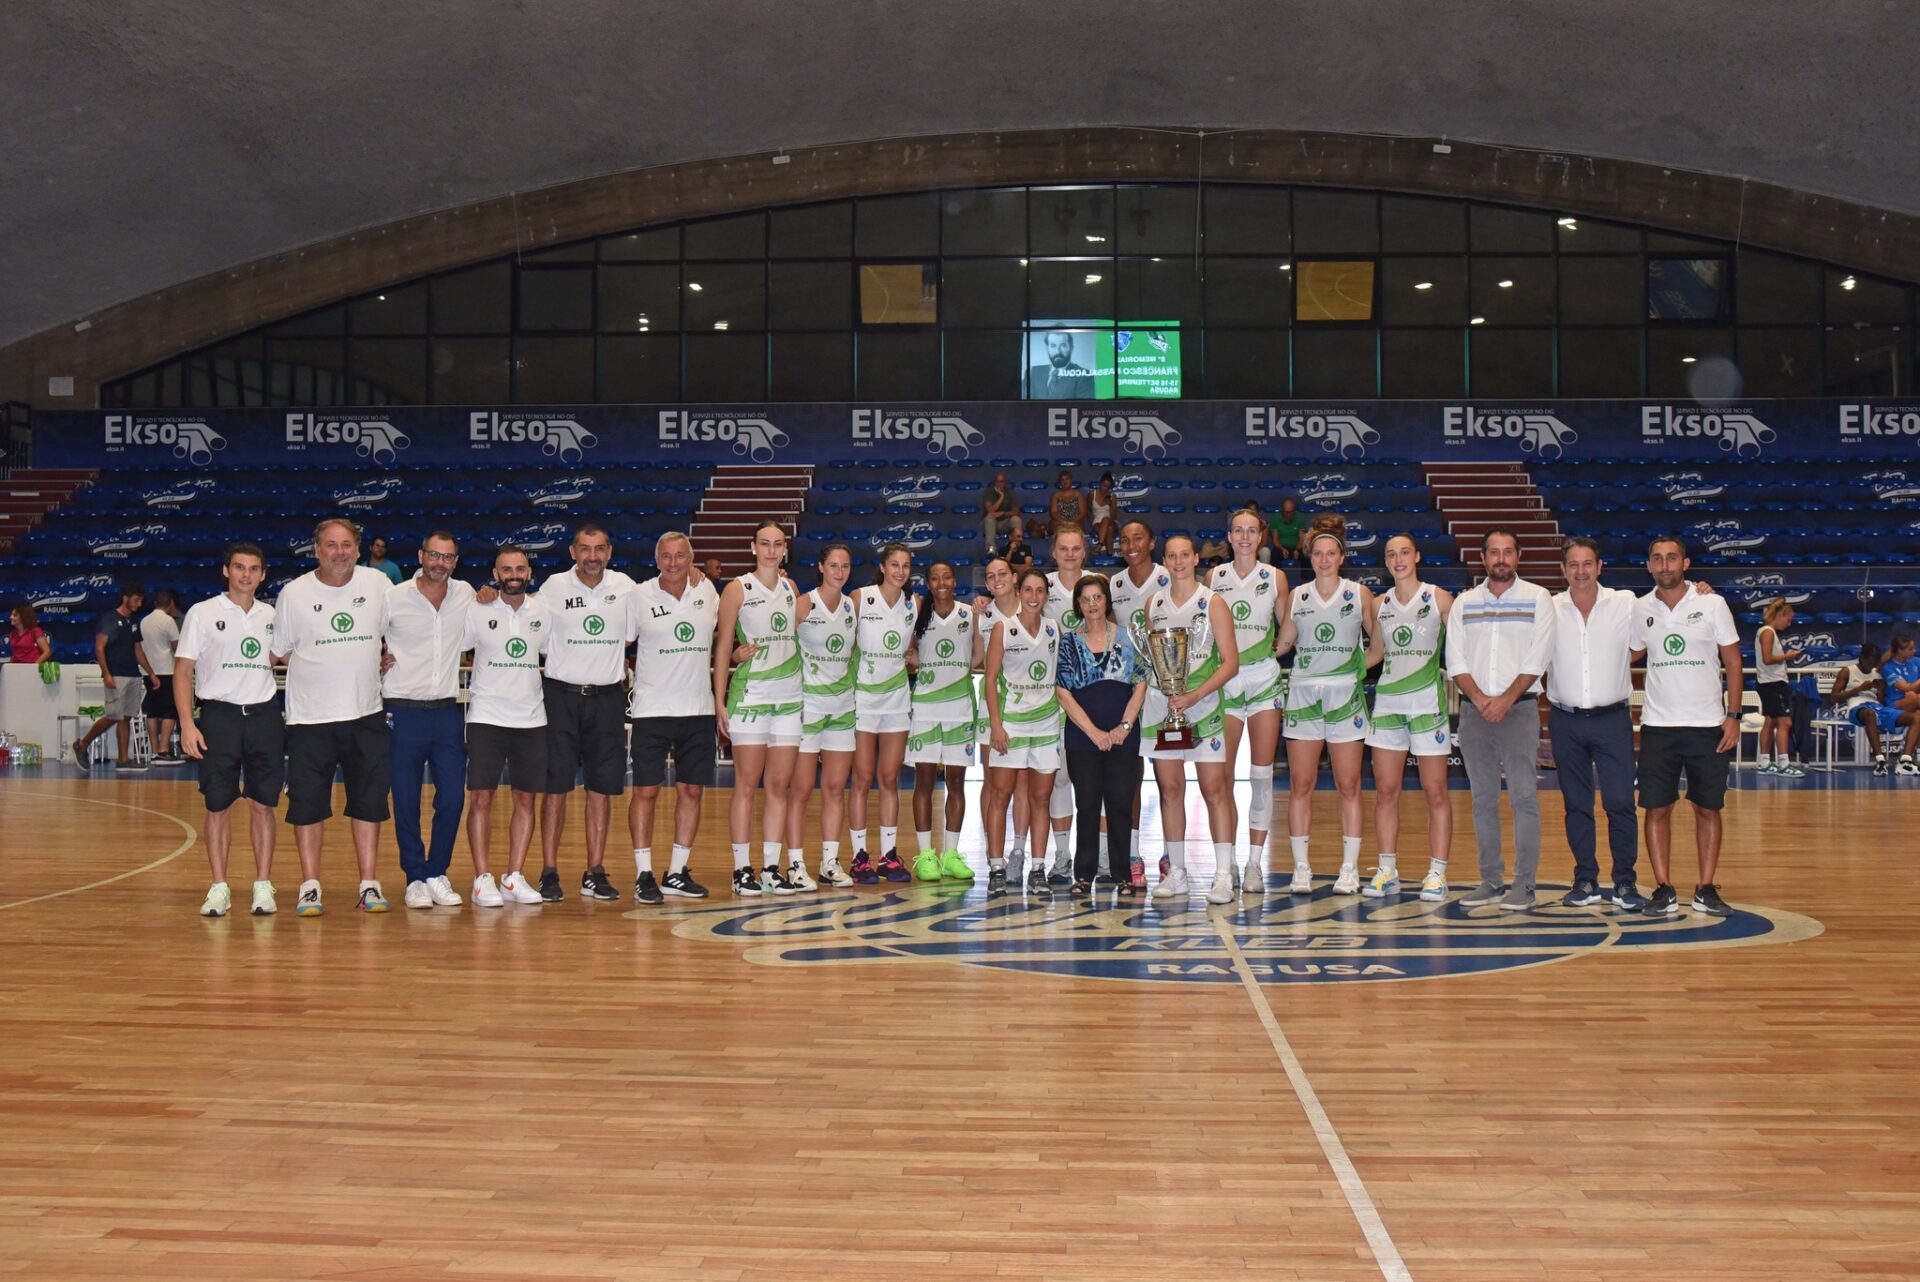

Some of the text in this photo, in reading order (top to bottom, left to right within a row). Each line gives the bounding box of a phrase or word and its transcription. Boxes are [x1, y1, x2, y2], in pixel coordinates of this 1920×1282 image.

[470, 412, 545, 441] Ekso
[659, 411, 735, 440] Ekso
[852, 409, 930, 439] Ekso
[1048, 408, 1127, 438] Ekso
[1245, 407, 1325, 437] Ekso
[1443, 407, 1522, 437] Ekso
[1642, 406, 1721, 436] Ekso
[1840, 405, 1920, 435] Ekso
[106, 416, 176, 443] Ekso
[287, 414, 359, 442] Ekso
[565, 596, 587, 609] M.R.
[651, 605, 671, 618] L.L.
[315, 635, 373, 646] Passalacqua
[753, 632, 797, 643] Passalacq
[804, 652, 850, 663] Passalacq
[862, 651, 903, 659] Passalac
[1384, 649, 1432, 657] ssalacqua
[222, 662, 272, 671] Passalacqu
[1652, 660, 1706, 668] Passalacqua
[1008, 682, 1056, 690] Passalac
[1013, 692, 1024, 704] 7
[740, 708, 759, 723] 77
[1286, 714, 1297, 728] 15
[1112, 936, 1368, 950] KLEB
[1147, 963, 1407, 976] RAGUSA
